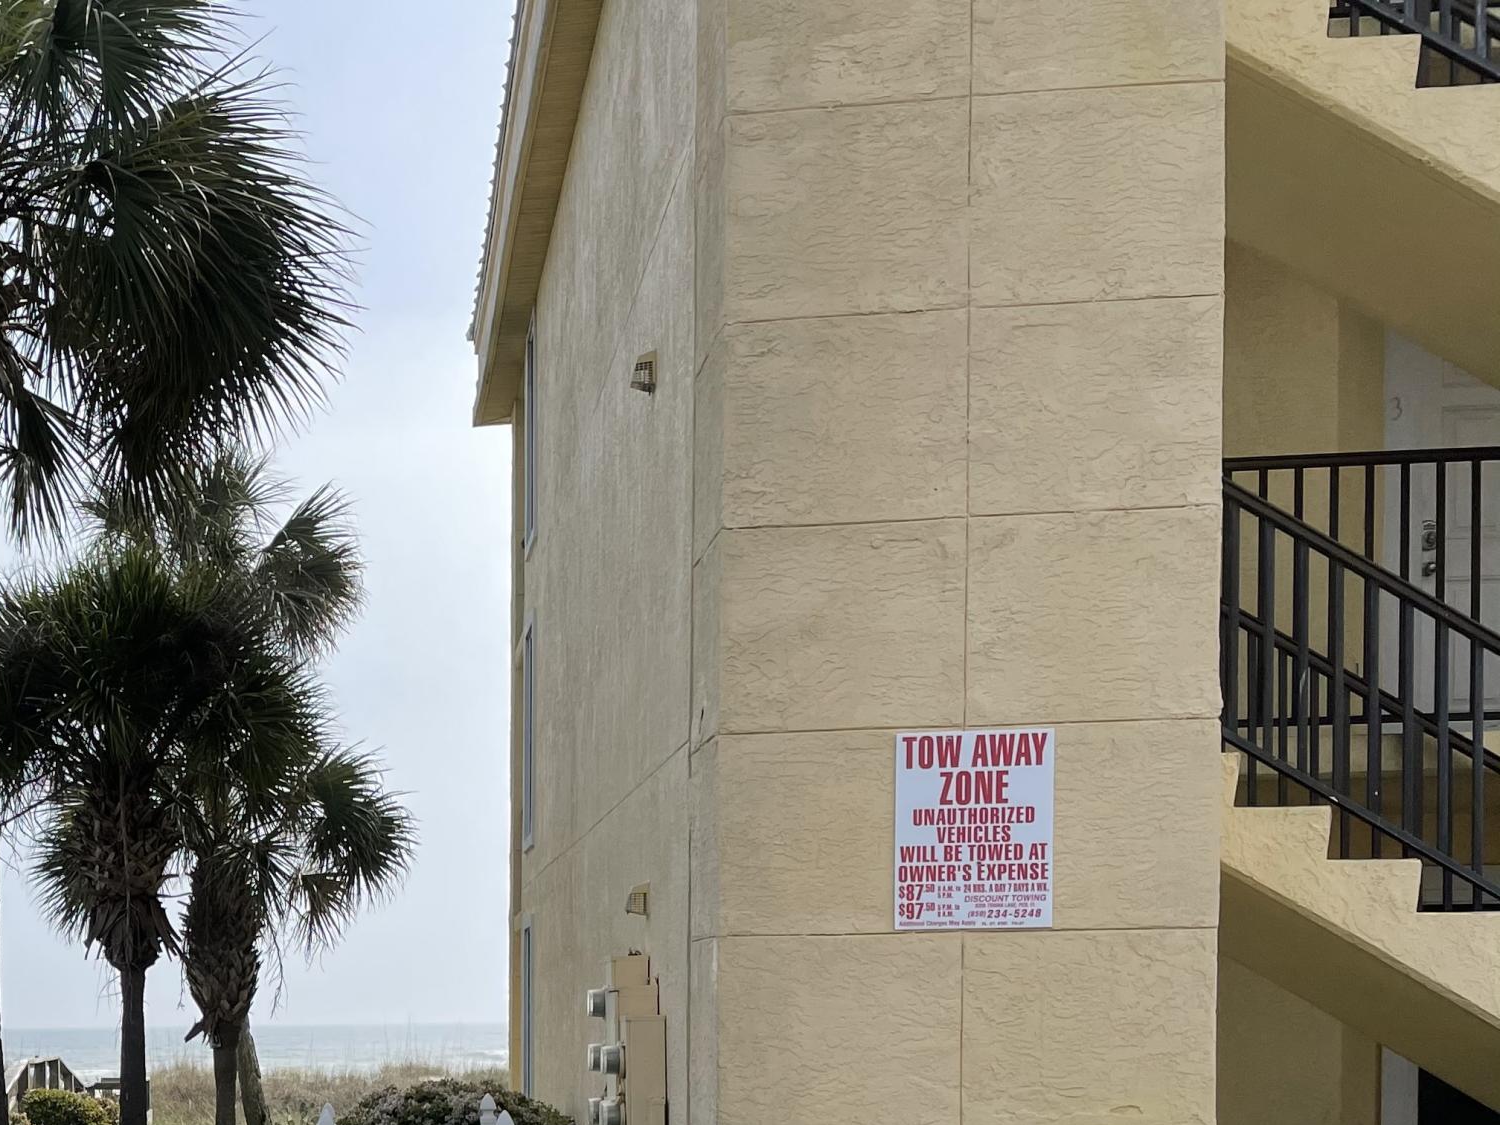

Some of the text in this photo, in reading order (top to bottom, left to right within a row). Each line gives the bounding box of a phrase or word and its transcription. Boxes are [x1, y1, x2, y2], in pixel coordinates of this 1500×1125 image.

[1389, 396, 1403, 421] 3
[902, 733, 1048, 769] TOW AWAY
[939, 770, 1009, 806] ZONE
[913, 806, 1035, 826] UNAUTHORIZED
[937, 825, 1011, 844] VEHICLES
[900, 843, 1048, 863] WILL BE TOWED AT
[898, 863, 1049, 882] OWNER'S EXPENSE
[963, 883, 972, 893] 24
[989, 883, 993, 892] A
[994, 883, 1006, 892] DAY
[1008, 883, 1012, 892] 7
[1013, 882, 1029, 892] DAYS
[1030, 882, 1035, 892] A
[1012, 894, 1046, 902] TOWING
